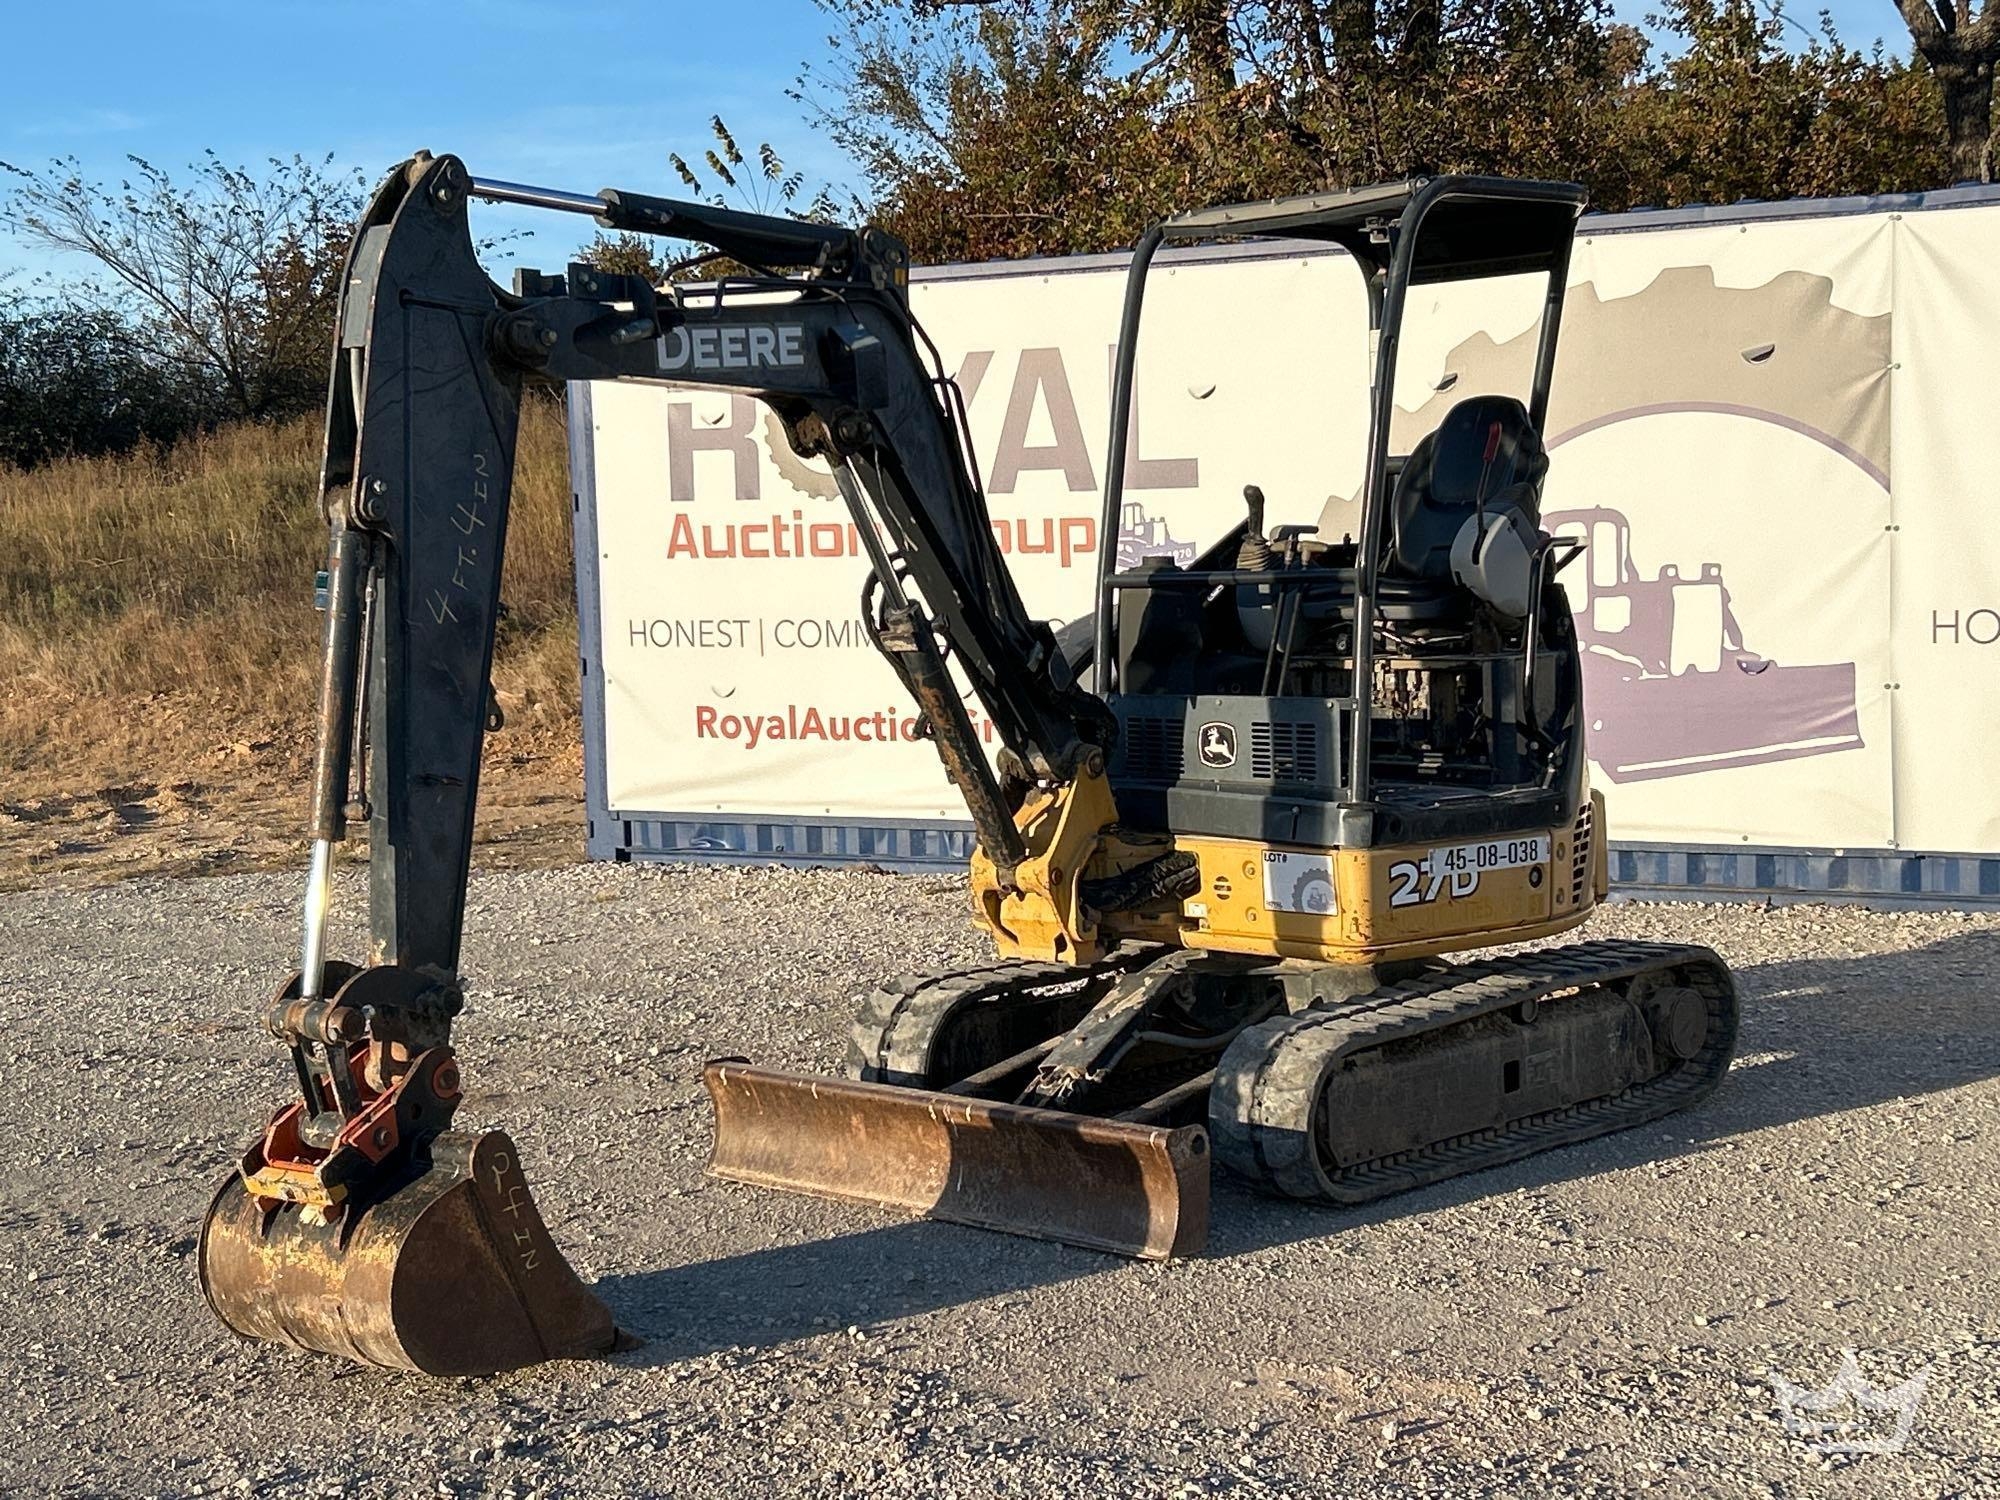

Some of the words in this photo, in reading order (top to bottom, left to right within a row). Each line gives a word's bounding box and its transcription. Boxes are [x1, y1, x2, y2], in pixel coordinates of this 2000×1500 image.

[656, 325, 804, 369] DEERE
[450, 501, 486, 536] 4
[452, 545, 478, 591] FT.
[426, 588, 459, 624] 4
[629, 619, 751, 648] HONEST
[1264, 852, 1288, 864] LOT#
[1444, 839, 1538, 871] 45-08-038
[1389, 857, 1481, 909] 27D
